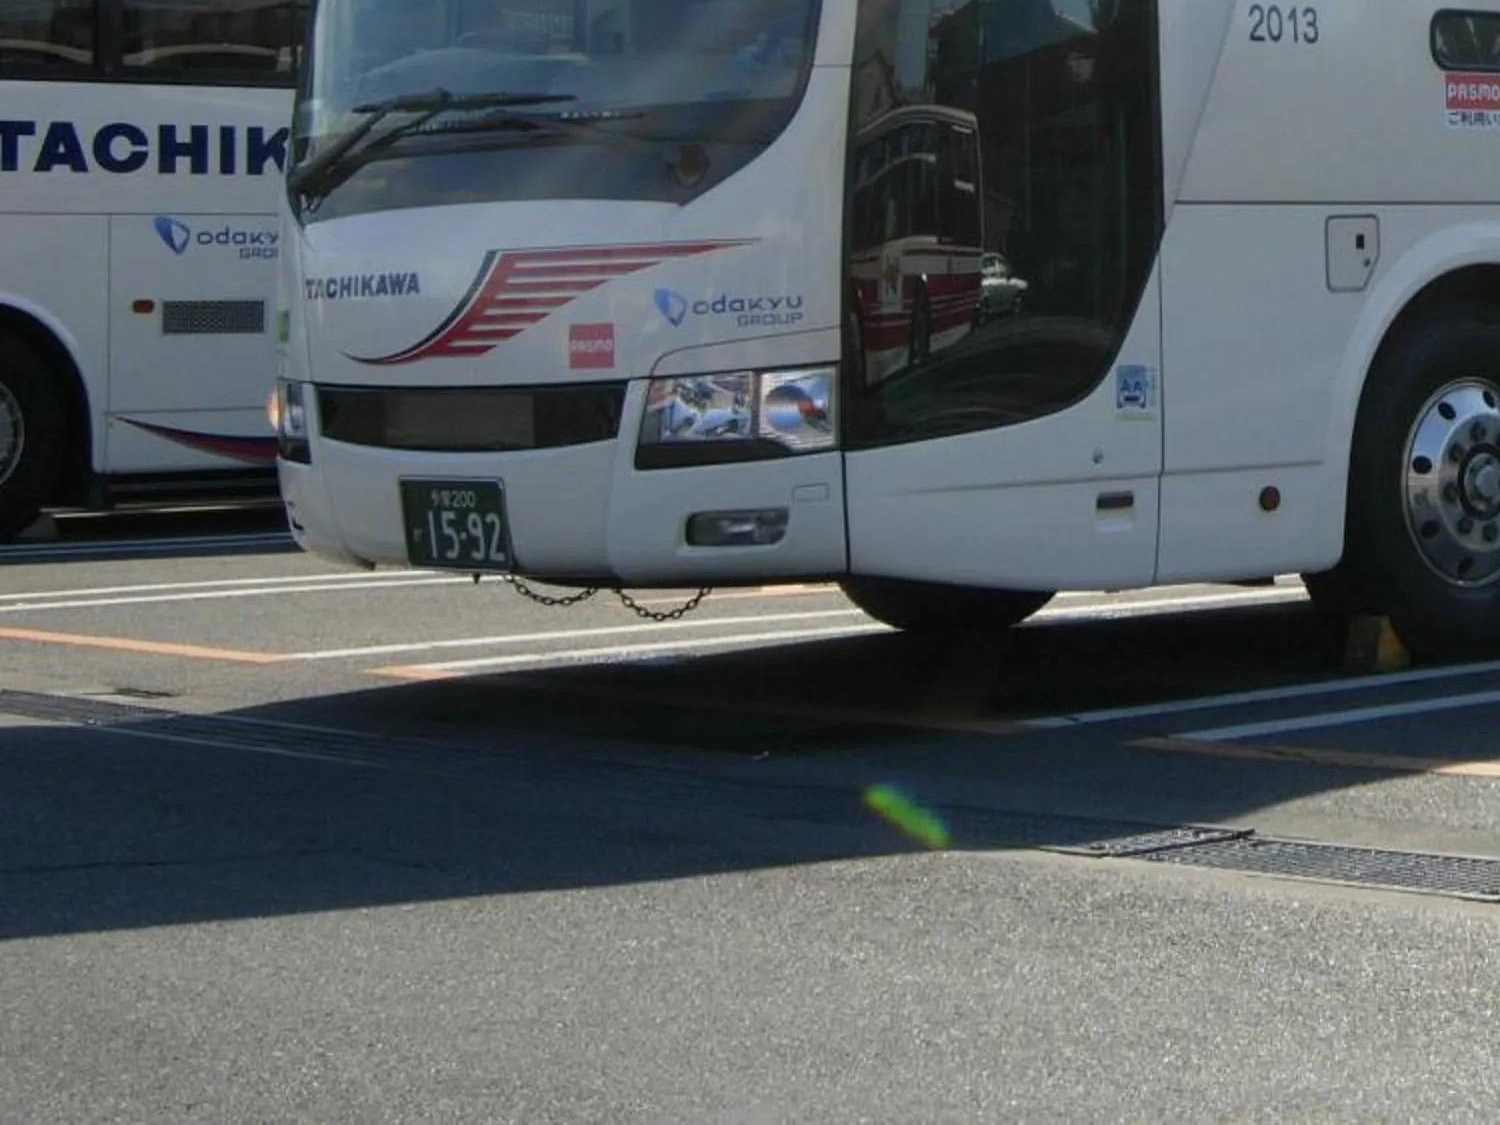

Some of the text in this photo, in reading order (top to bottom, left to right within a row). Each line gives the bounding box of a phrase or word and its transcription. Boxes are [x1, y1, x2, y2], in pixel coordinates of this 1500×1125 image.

[1248, 3, 1319, 44] 2013
[304, 271, 421, 300] TACHIKAWA
[737, 312, 804, 328] GROUP
